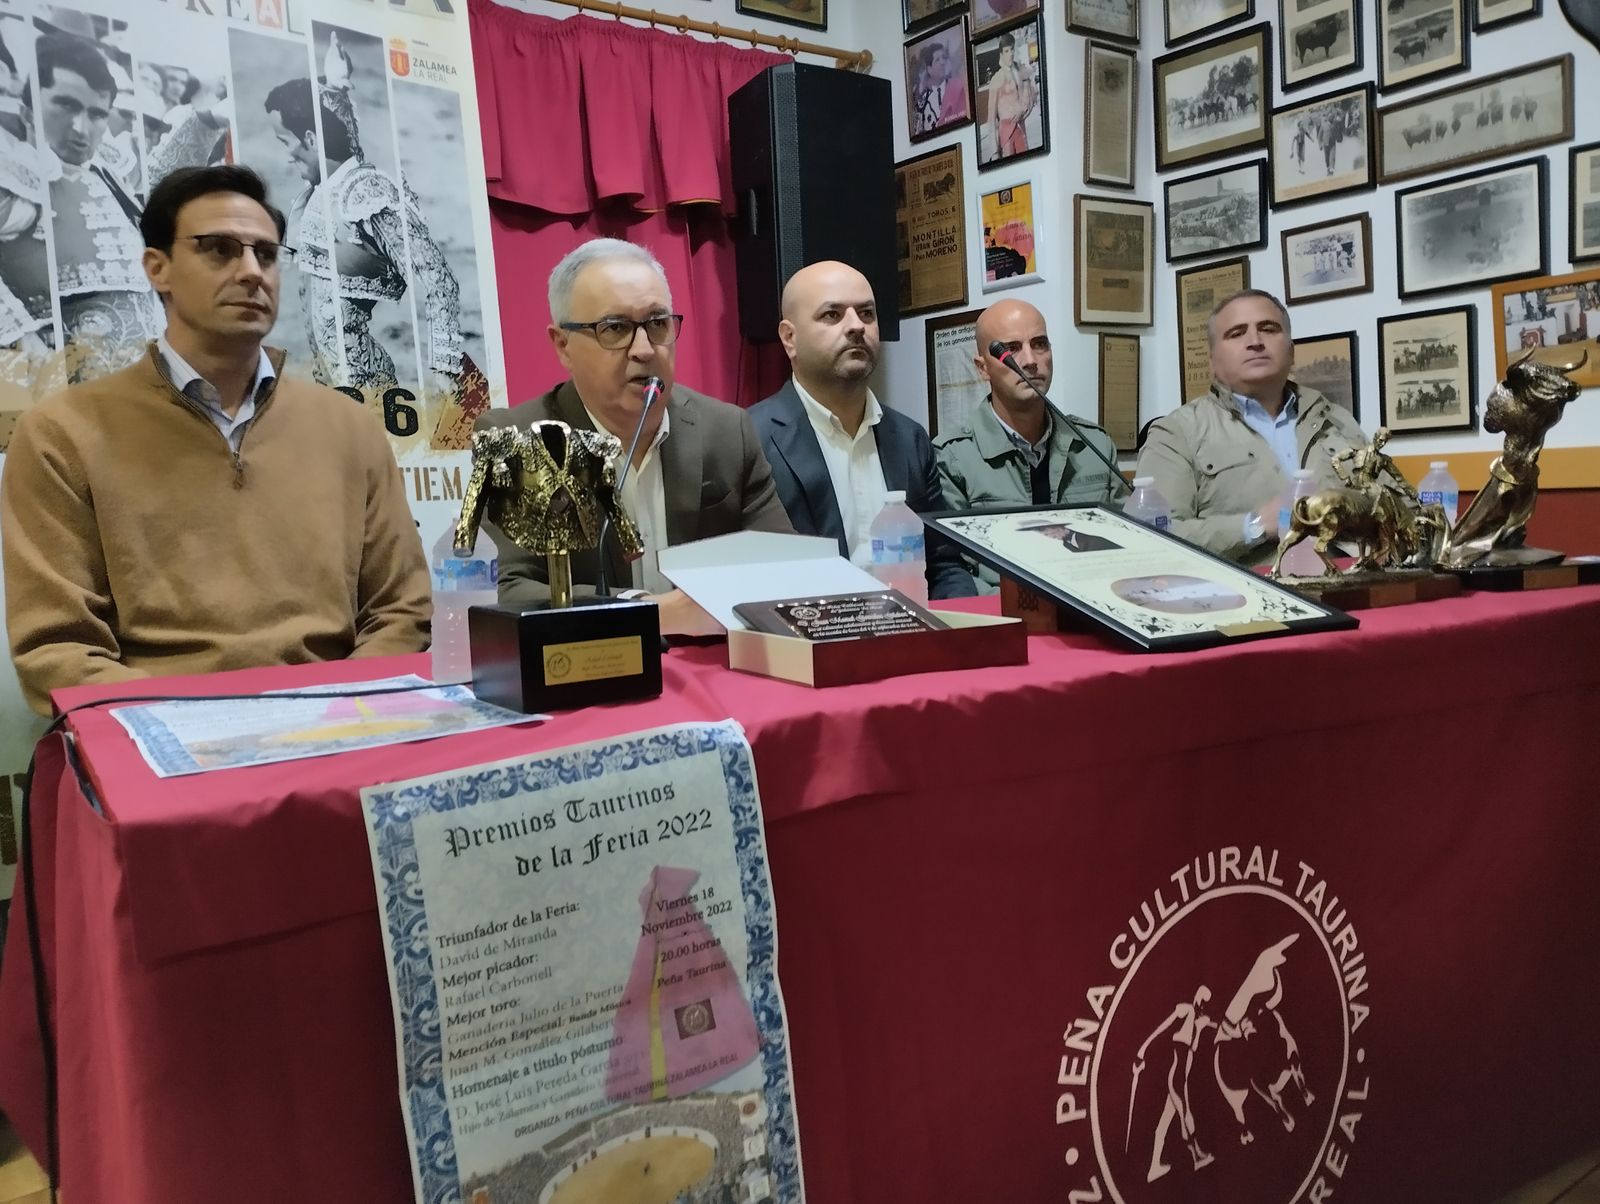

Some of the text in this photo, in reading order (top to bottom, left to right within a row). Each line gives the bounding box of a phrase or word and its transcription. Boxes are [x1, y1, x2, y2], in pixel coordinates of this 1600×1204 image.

[413, 57, 457, 75] ZALAMEA
[912, 225, 957, 243] MONTILLA
[443, 781, 676, 858] Premios Taurinos
[514, 808, 713, 876] de la Feria 2022
[641, 900, 733, 937] Noviembre 2022
[656, 887, 715, 912] Viernes 18
[435, 902, 581, 949] Triunfador de la Feria:
[440, 927, 558, 969] David de Miranda
[661, 937, 722, 964] 20.00 horas
[442, 953, 540, 990] Mejor picador:
[445, 966, 553, 1008] Rafael Carbonell
[687, 960, 727, 979] Taurina
[1056, 845, 1371, 1125] PEÑA CULTURAL TAURINA
[446, 998, 521, 1028] Mejor toro:
[520, 1007, 549, 1025] Julio
[552, 1000, 567, 1012] de
[571, 994, 582, 1008] la
[585, 983, 625, 1003] Puerta
[448, 1036, 507, 1061] Mención
[510, 1017, 567, 1042] Especial:
[449, 1060, 479, 1080] Juan
[452, 1068, 520, 1100] Homenaje
[523, 1067, 531, 1077] a
[533, 1053, 567, 1073] título
[571, 1035, 624, 1063] póstumo
[476, 1096, 502, 1116] José
[536, 1073, 577, 1094] Pereda
[1308, 1075, 1370, 1204] REAL
